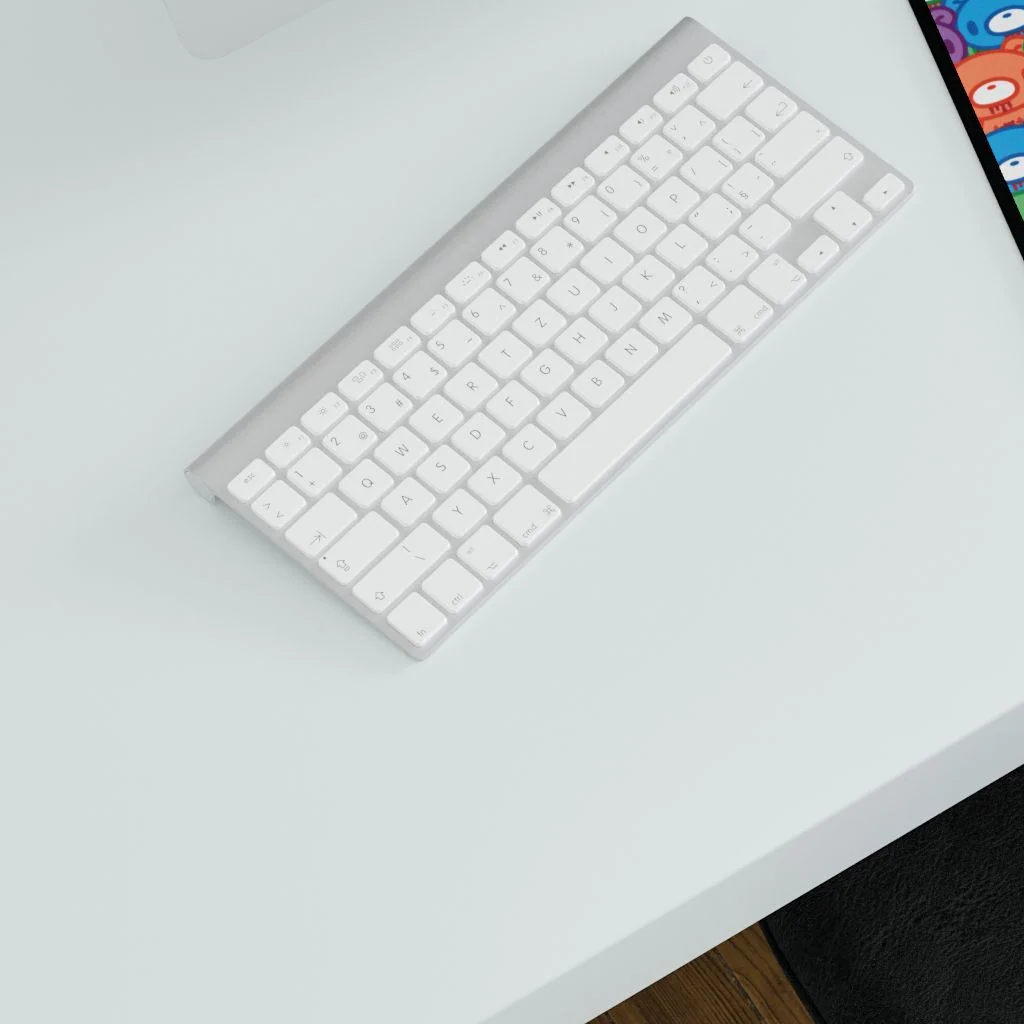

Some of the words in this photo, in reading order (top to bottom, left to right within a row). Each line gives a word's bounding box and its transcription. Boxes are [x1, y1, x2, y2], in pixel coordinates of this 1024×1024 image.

[294, 470, 303, 478] 1
[330, 437, 341, 446] 2
[365, 405, 376, 414] 3
[402, 372, 411, 380] 4
[436, 341, 445, 350] 5
[470, 310, 480, 318] 6
[503, 278, 512, 287] 7
[538, 248, 548, 256] 8
[362, 478, 376, 488] Q
[394, 444, 409, 456] W
[432, 413, 443, 423] E
[466, 382, 478, 391] R
[500, 348, 511, 357] T
[535, 317, 547, 328] Z
[568, 285, 583, 296] U
[669, 194, 678, 203] P
[401, 496, 413, 506] A
[436, 462, 446, 471] S
[470, 430, 481, 440] D
[504, 397, 514, 407] F
[540, 364, 552, 374] G
[572, 332, 586, 344] H
[609, 302, 618, 311] J
[640, 270, 653, 280] K
[532, 274, 544, 282] &
[451, 505, 463, 515] Y
[487, 472, 501, 485] X
[523, 441, 534, 450] C
[555, 408, 567, 417] V
[591, 377, 602, 387] B
[624, 344, 638, 355] N
[658, 312, 672, 325] M
